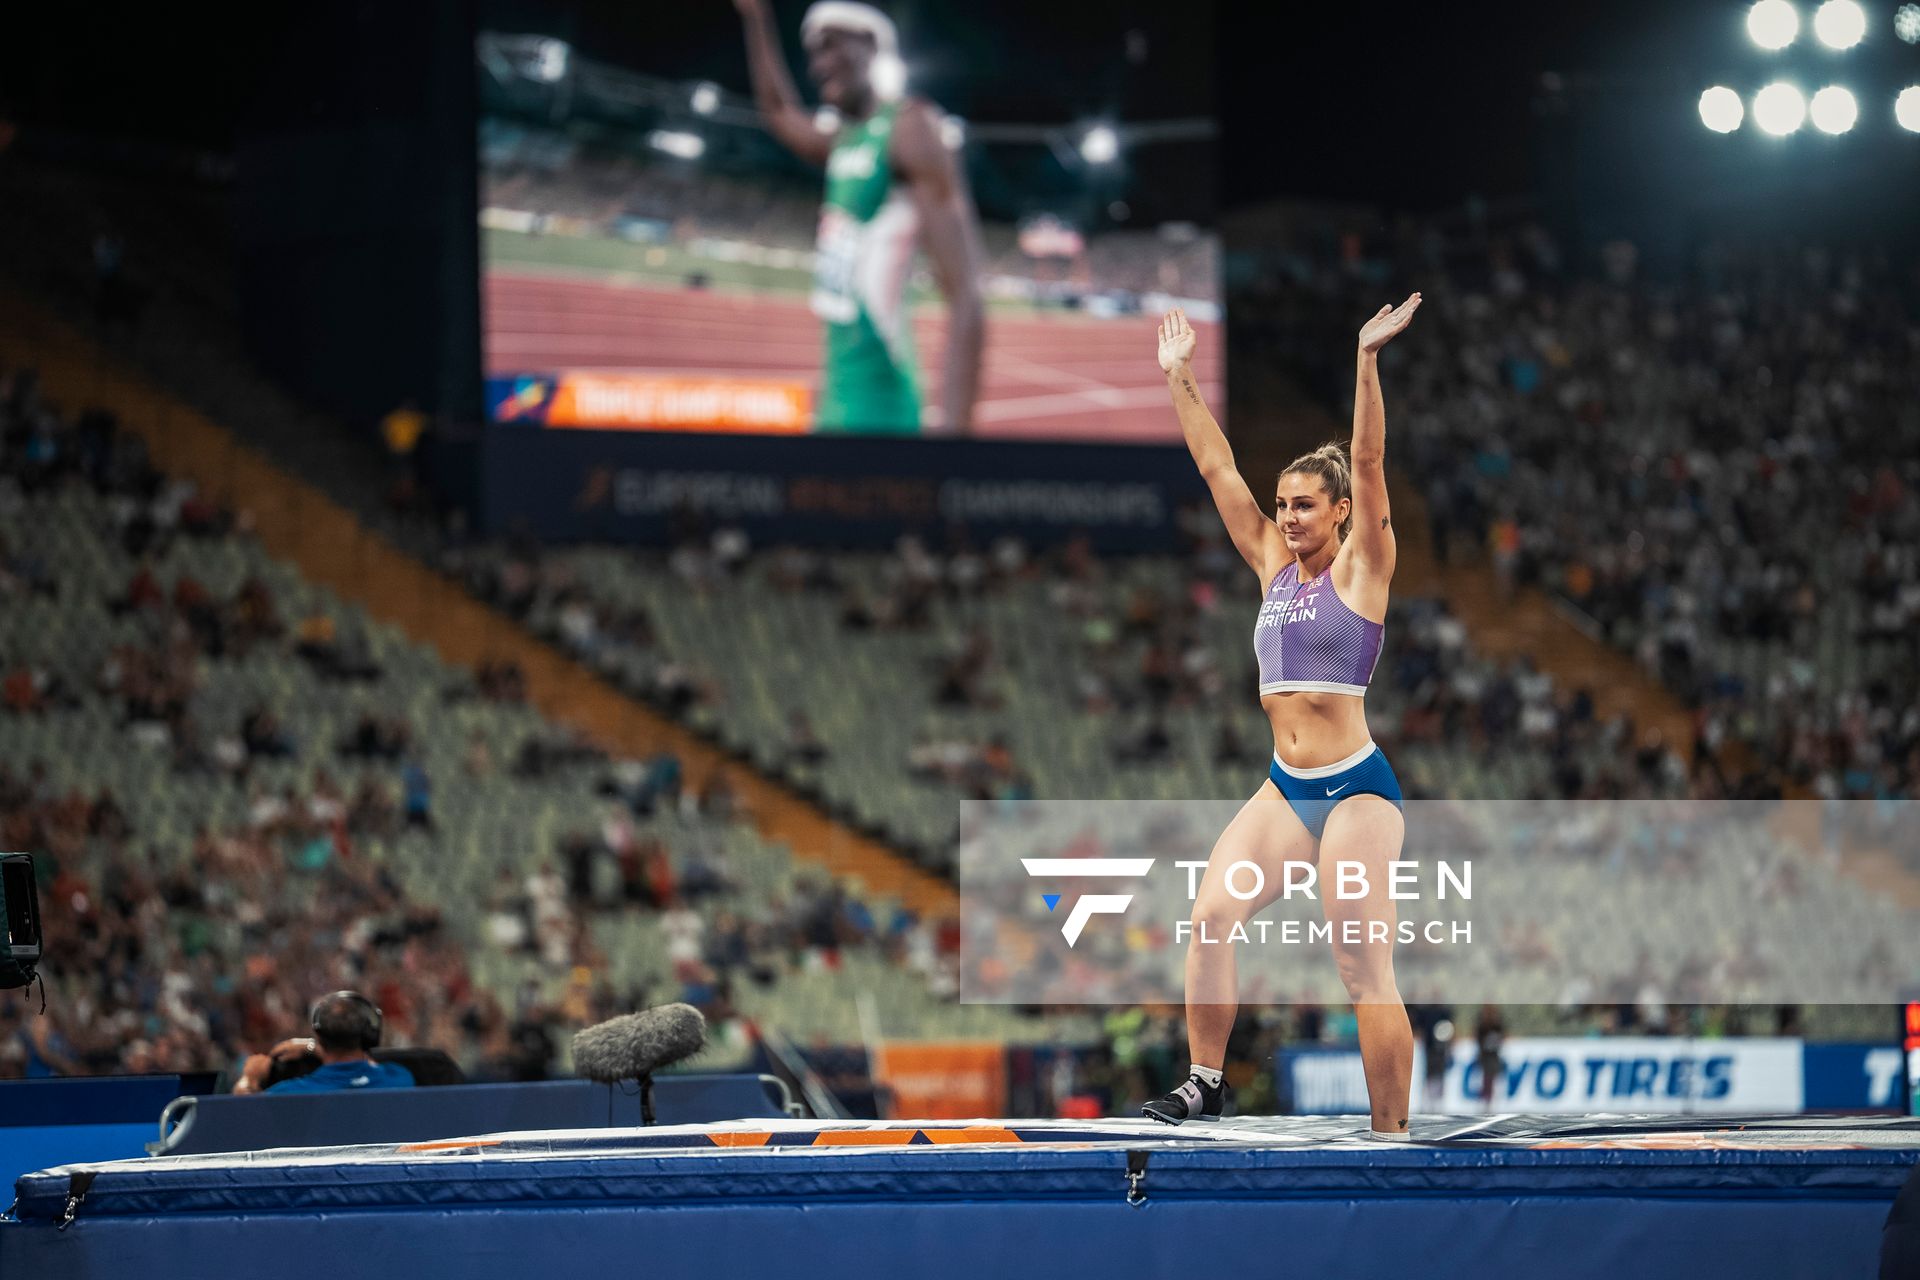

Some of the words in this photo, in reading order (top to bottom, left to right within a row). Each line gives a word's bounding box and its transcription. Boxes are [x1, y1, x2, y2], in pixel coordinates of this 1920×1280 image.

[1262, 593, 1319, 613] GREAT
[1256, 608, 1316, 629] BRITAIN
[1446, 1057, 1567, 1098] OYO
[1586, 1056, 1733, 1098] TIRES
